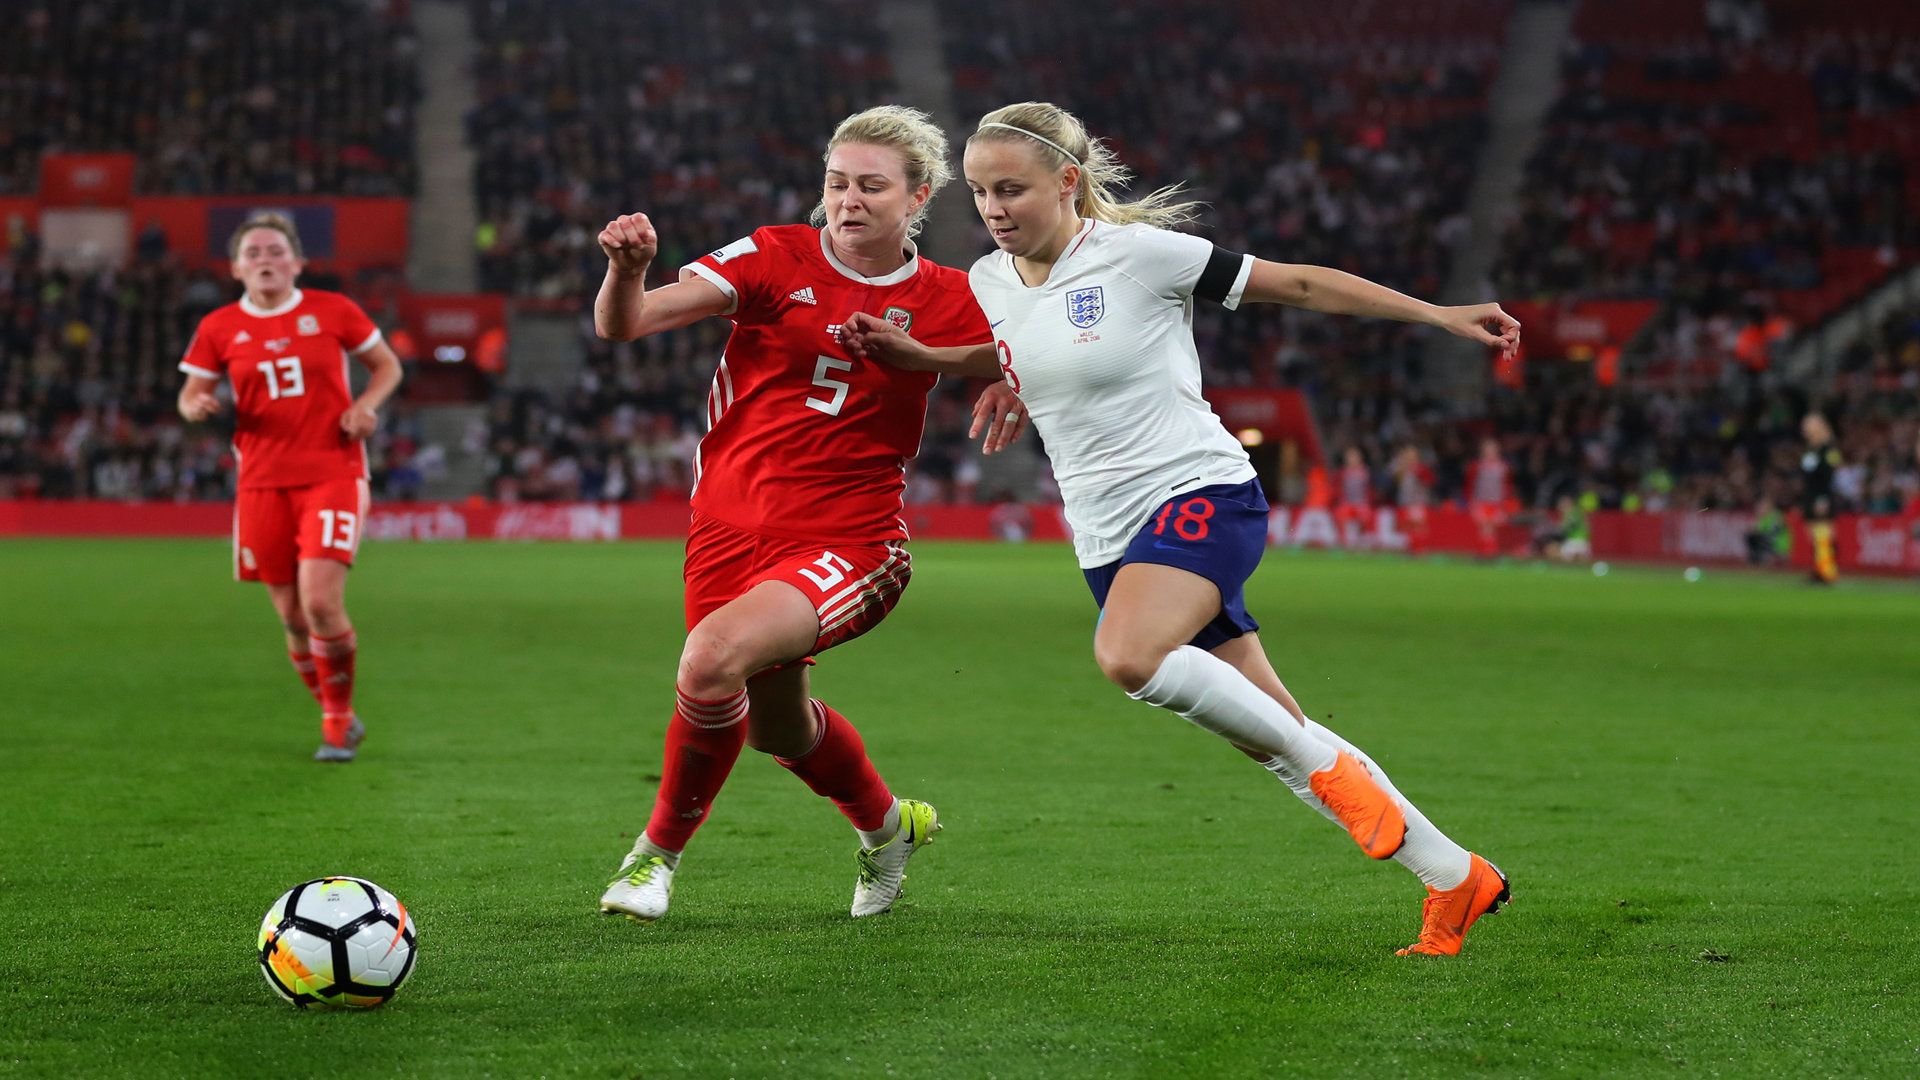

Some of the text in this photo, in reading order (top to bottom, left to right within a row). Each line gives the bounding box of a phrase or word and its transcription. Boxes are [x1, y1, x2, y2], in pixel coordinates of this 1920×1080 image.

[790, 293, 817, 305] adidas
[257, 356, 305, 400] 13
[805, 354, 852, 416] 5
[318, 509, 356, 551] 13
[1153, 497, 1215, 541] 18
[797, 551, 854, 592] 5
